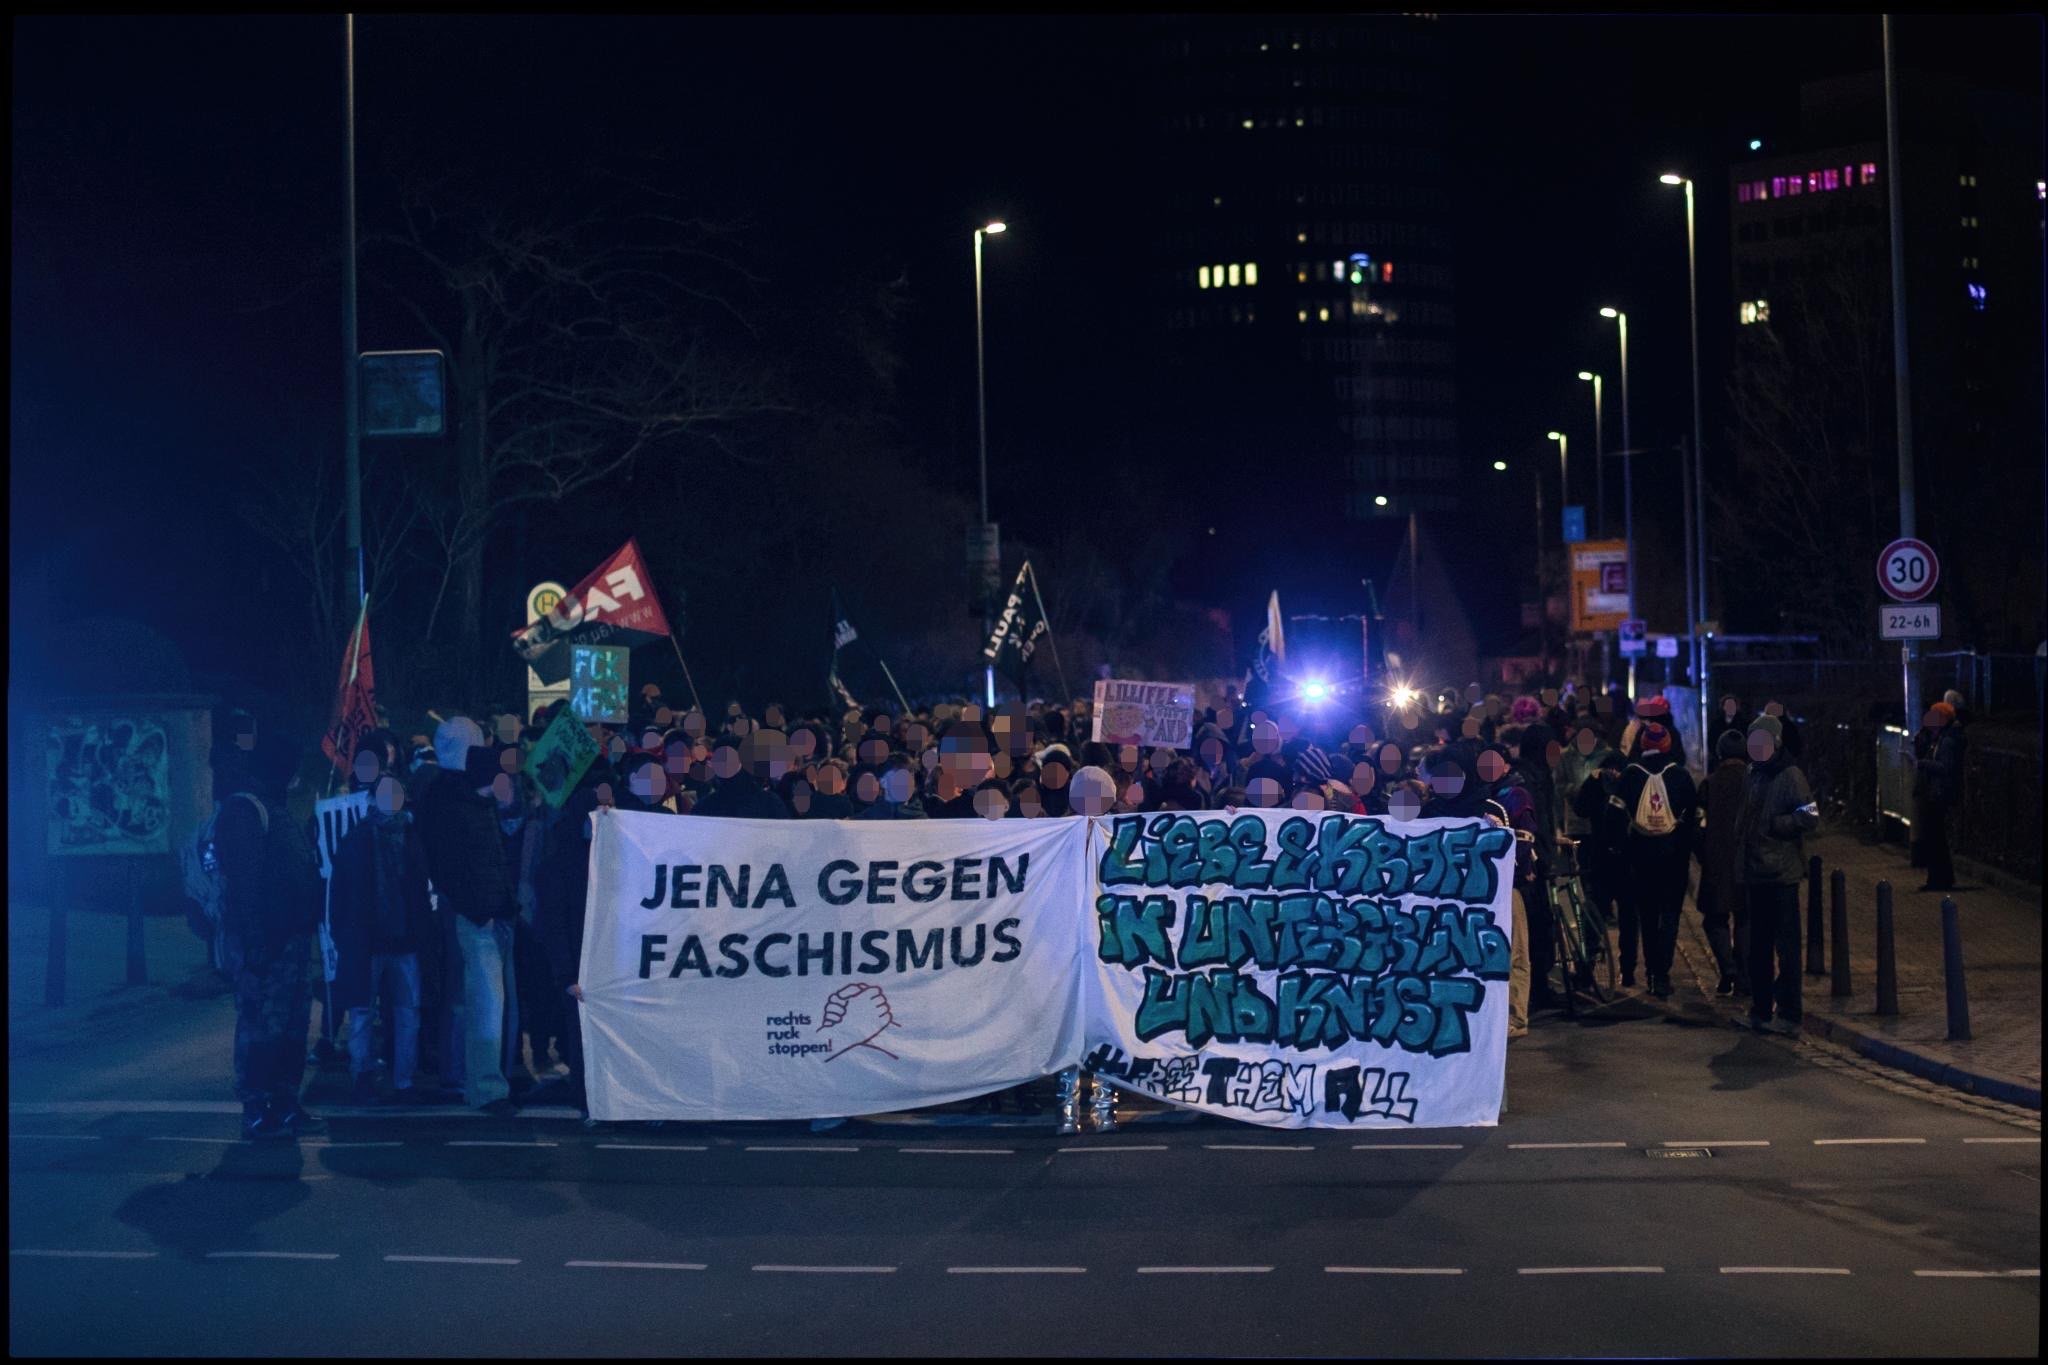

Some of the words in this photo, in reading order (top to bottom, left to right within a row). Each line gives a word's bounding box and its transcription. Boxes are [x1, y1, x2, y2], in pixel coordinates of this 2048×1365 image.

[1891, 556, 1925, 583] 30
[1890, 614, 1931, 629] 22-6h
[575, 648, 620, 681] FCK
[1313, 814, 1513, 904] KRAFT
[641, 863, 797, 910] JENA
[817, 853, 1030, 905] GEGEN
[638, 917, 1023, 980] FASCHISMUS
[766, 1010, 811, 1026] rechts
[766, 1025, 800, 1040] ruck
[768, 1038, 833, 1058] stoppen!
[1202, 1057, 1316, 1116] THEM
[1325, 1065, 1419, 1124] ALL
